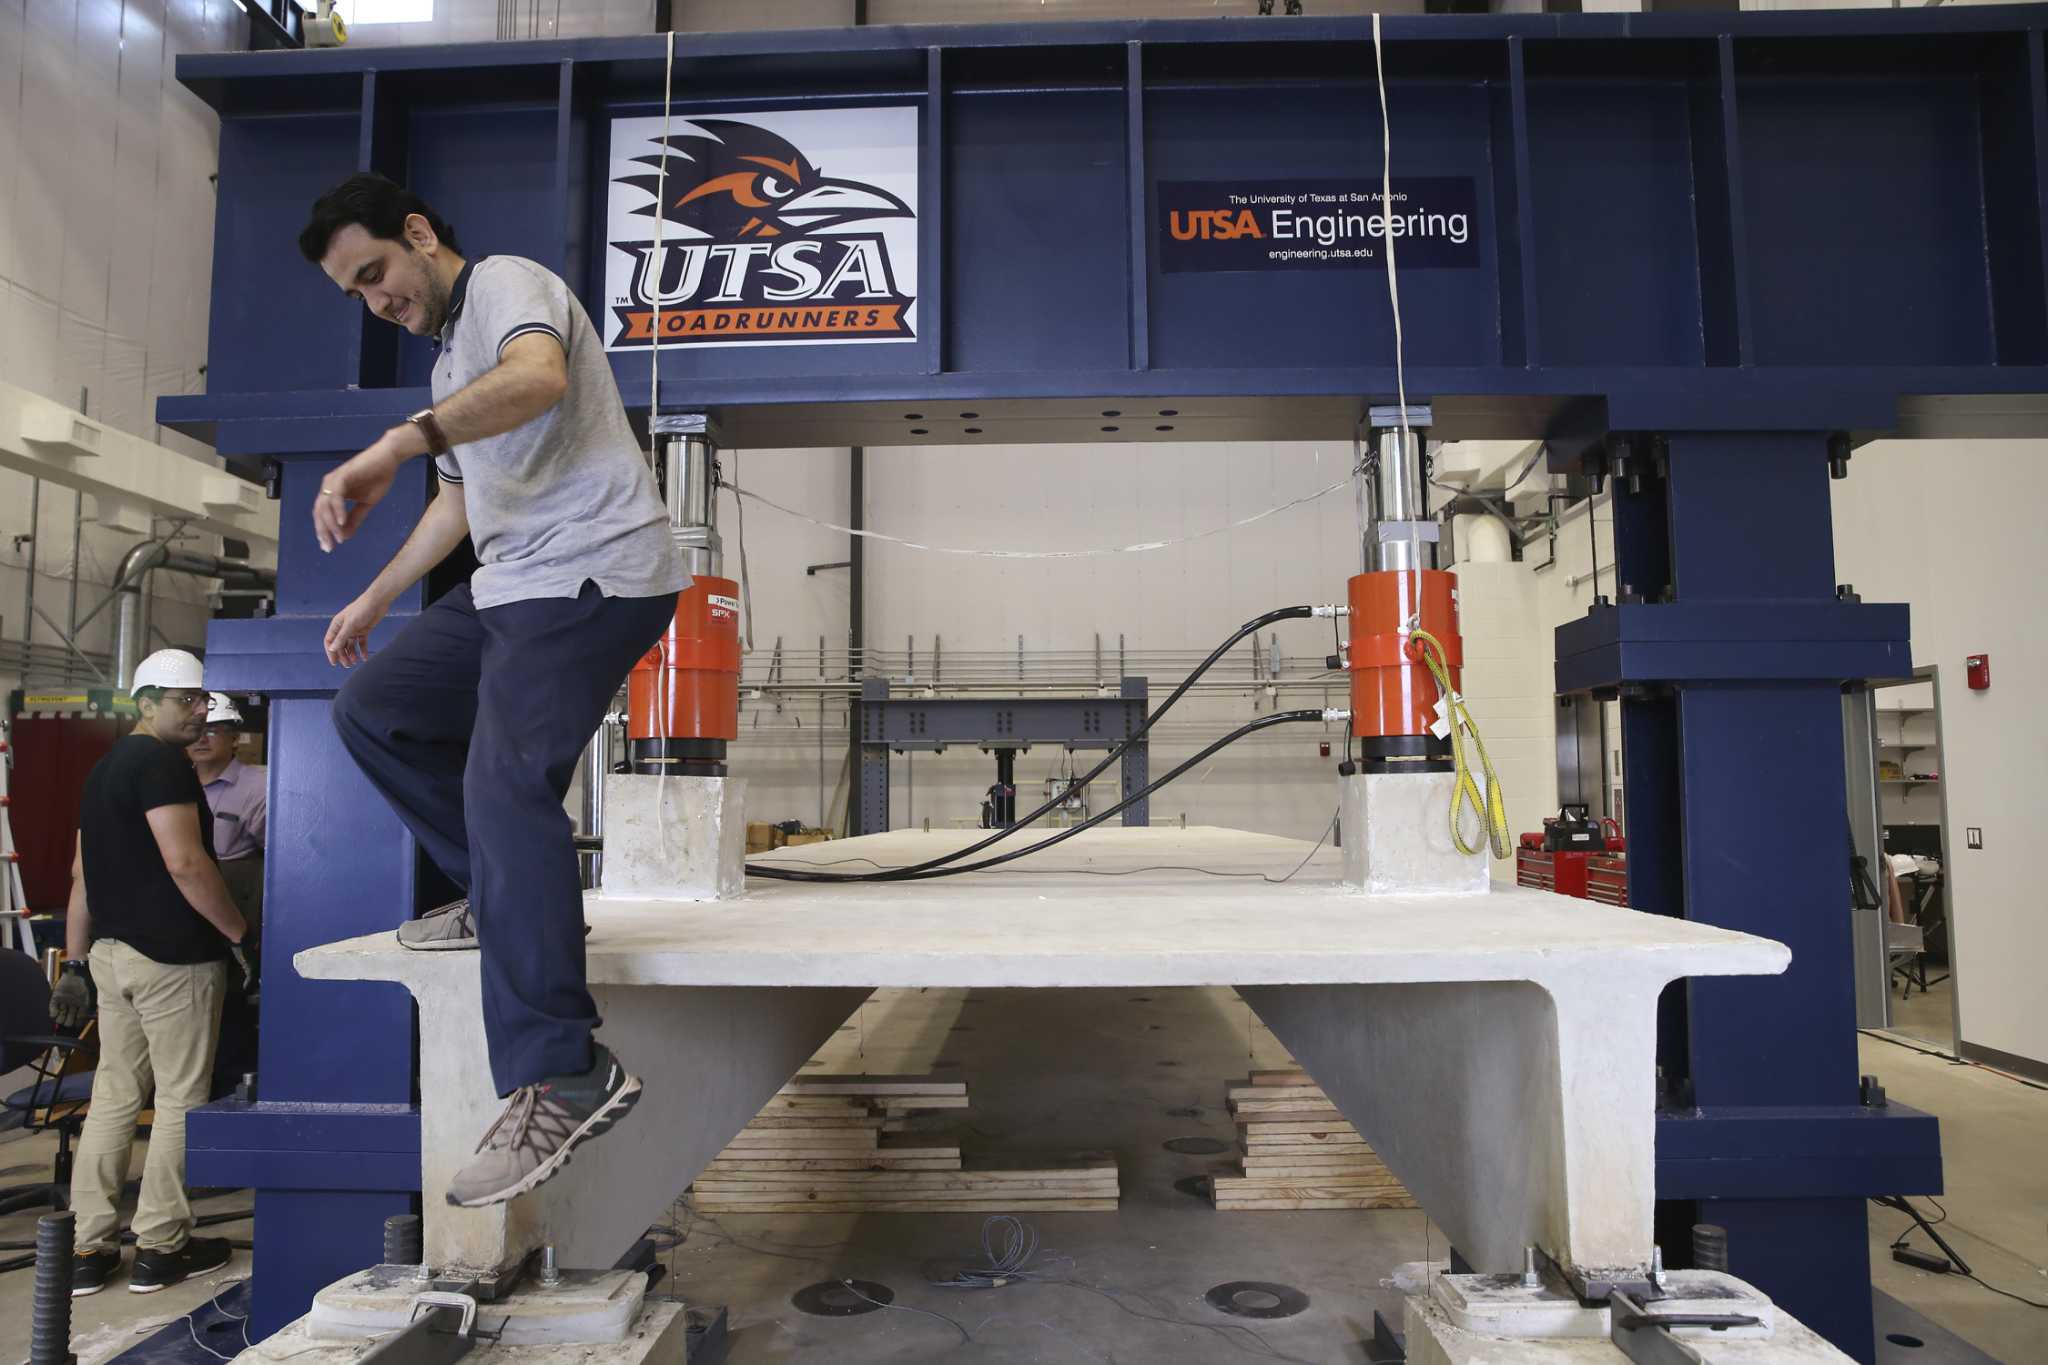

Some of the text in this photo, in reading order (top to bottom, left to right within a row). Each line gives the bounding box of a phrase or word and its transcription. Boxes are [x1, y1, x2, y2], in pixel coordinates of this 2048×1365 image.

[1229, 192, 1408, 206] The University of Texas at San Anonio
[1170, 207, 1468, 245] UTSA Engineering
[1268, 247, 1373, 262] engineering.utsa.edu
[637, 239, 894, 306] UTSA
